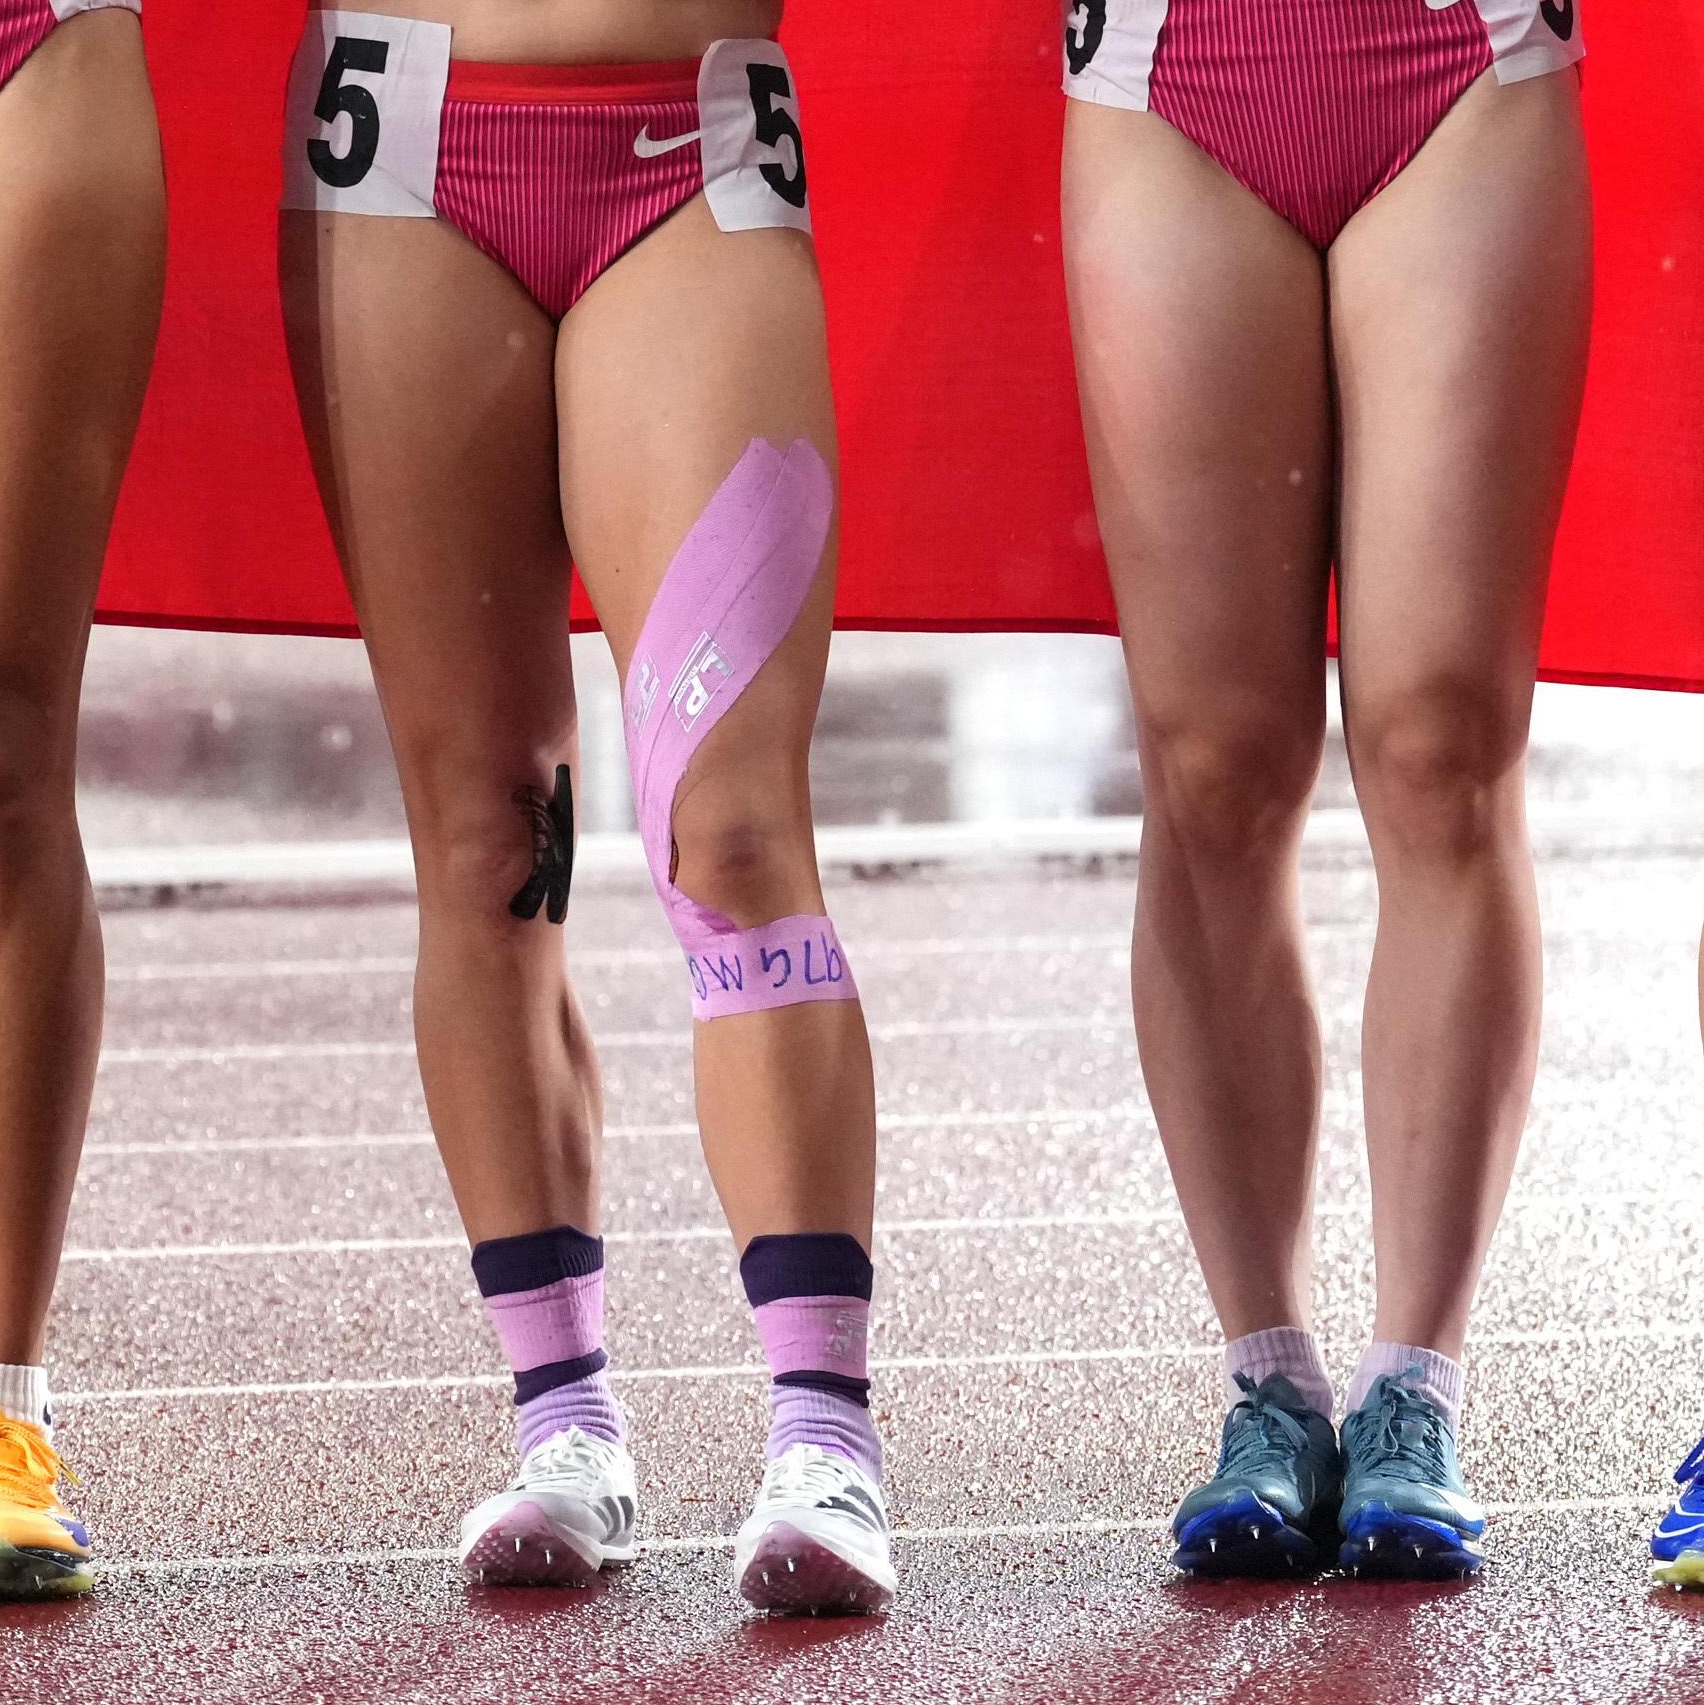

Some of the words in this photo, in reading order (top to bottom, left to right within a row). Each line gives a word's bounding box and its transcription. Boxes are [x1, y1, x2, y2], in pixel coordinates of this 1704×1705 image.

[307, 36, 389, 188] 5
[745, 63, 807, 209] 5
[686, 651, 731, 717] LP
